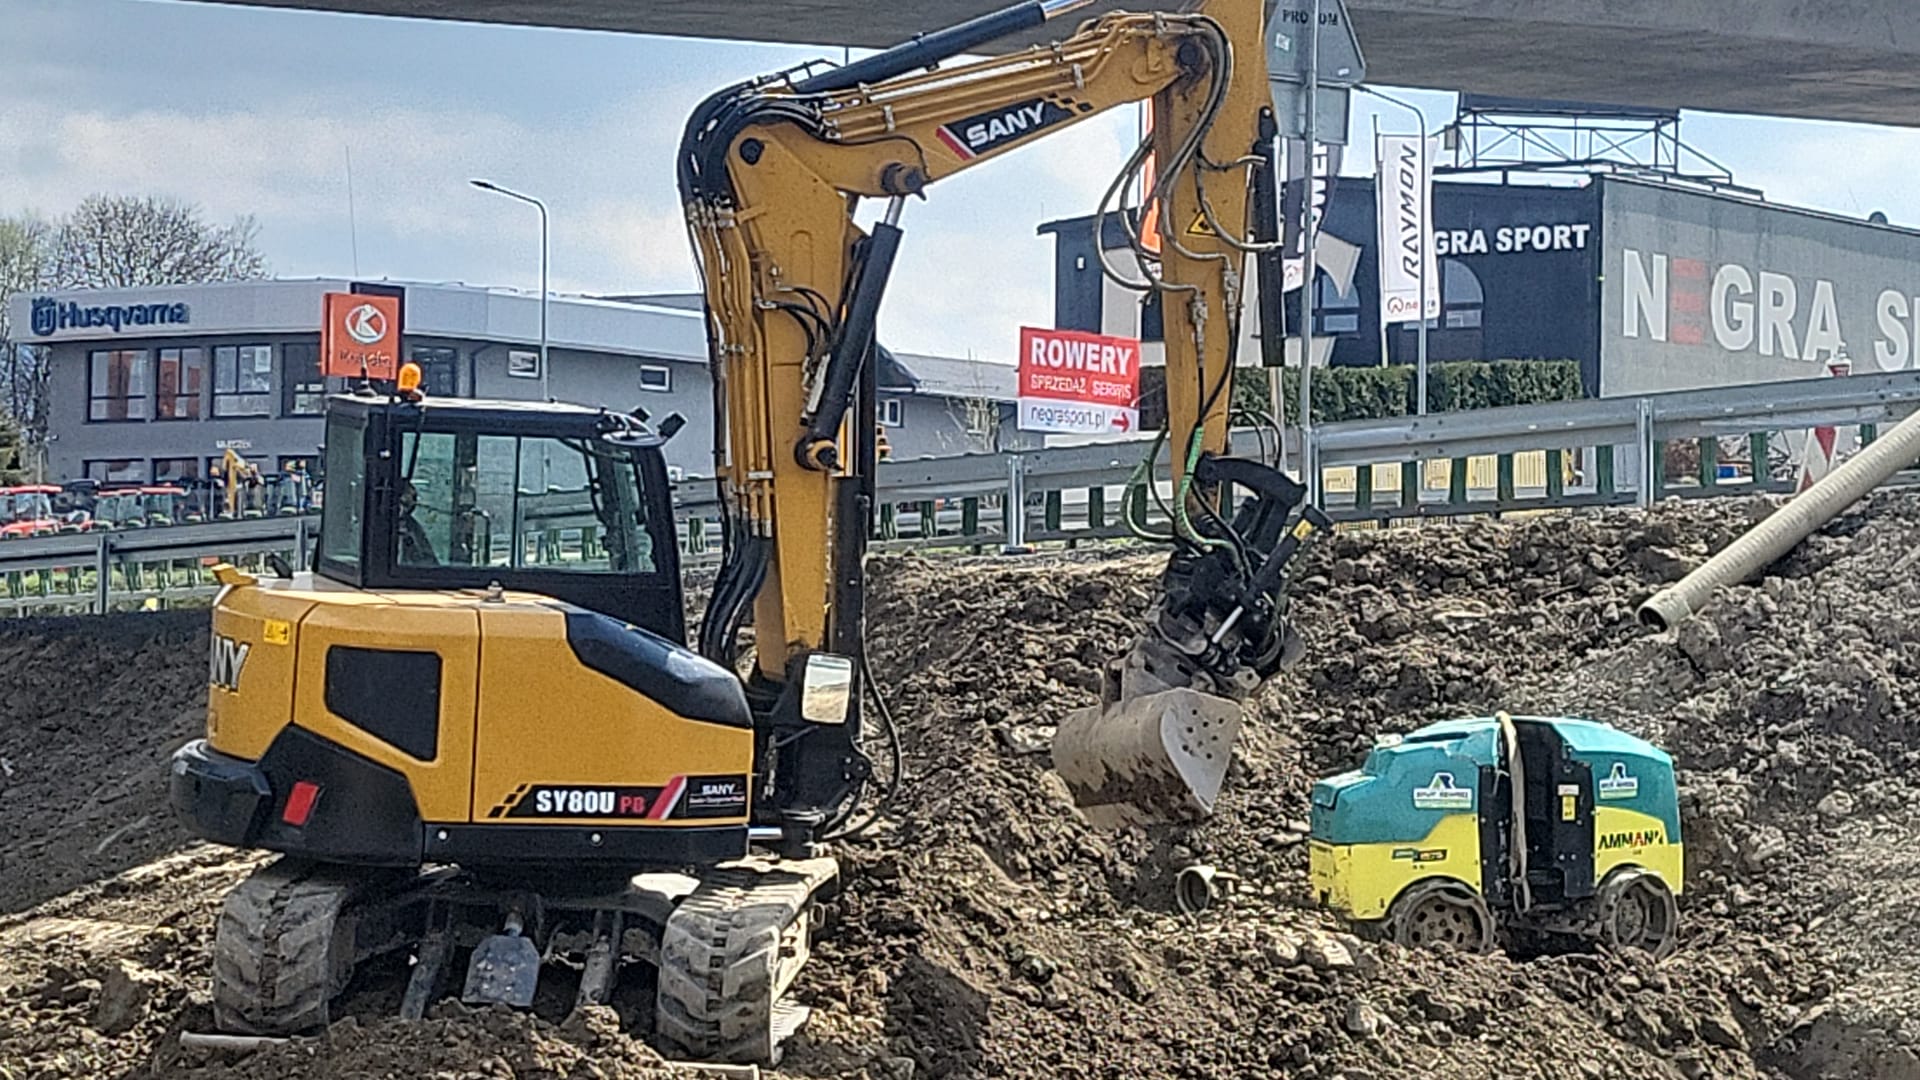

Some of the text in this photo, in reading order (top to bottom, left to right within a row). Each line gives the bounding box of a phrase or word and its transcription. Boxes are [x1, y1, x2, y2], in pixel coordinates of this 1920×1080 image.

[966, 101, 1045, 148] SANY
[1400, 144, 1420, 279] RAYMON
[1435, 224, 1591, 255] GRA SPORT
[58, 301, 190, 333] Husqvarna
[1623, 248, 1920, 372] NEGRA S
[1031, 337, 1133, 376] ROWERY
[210, 634, 250, 690] NY
[536, 790, 616, 814] SY80U
